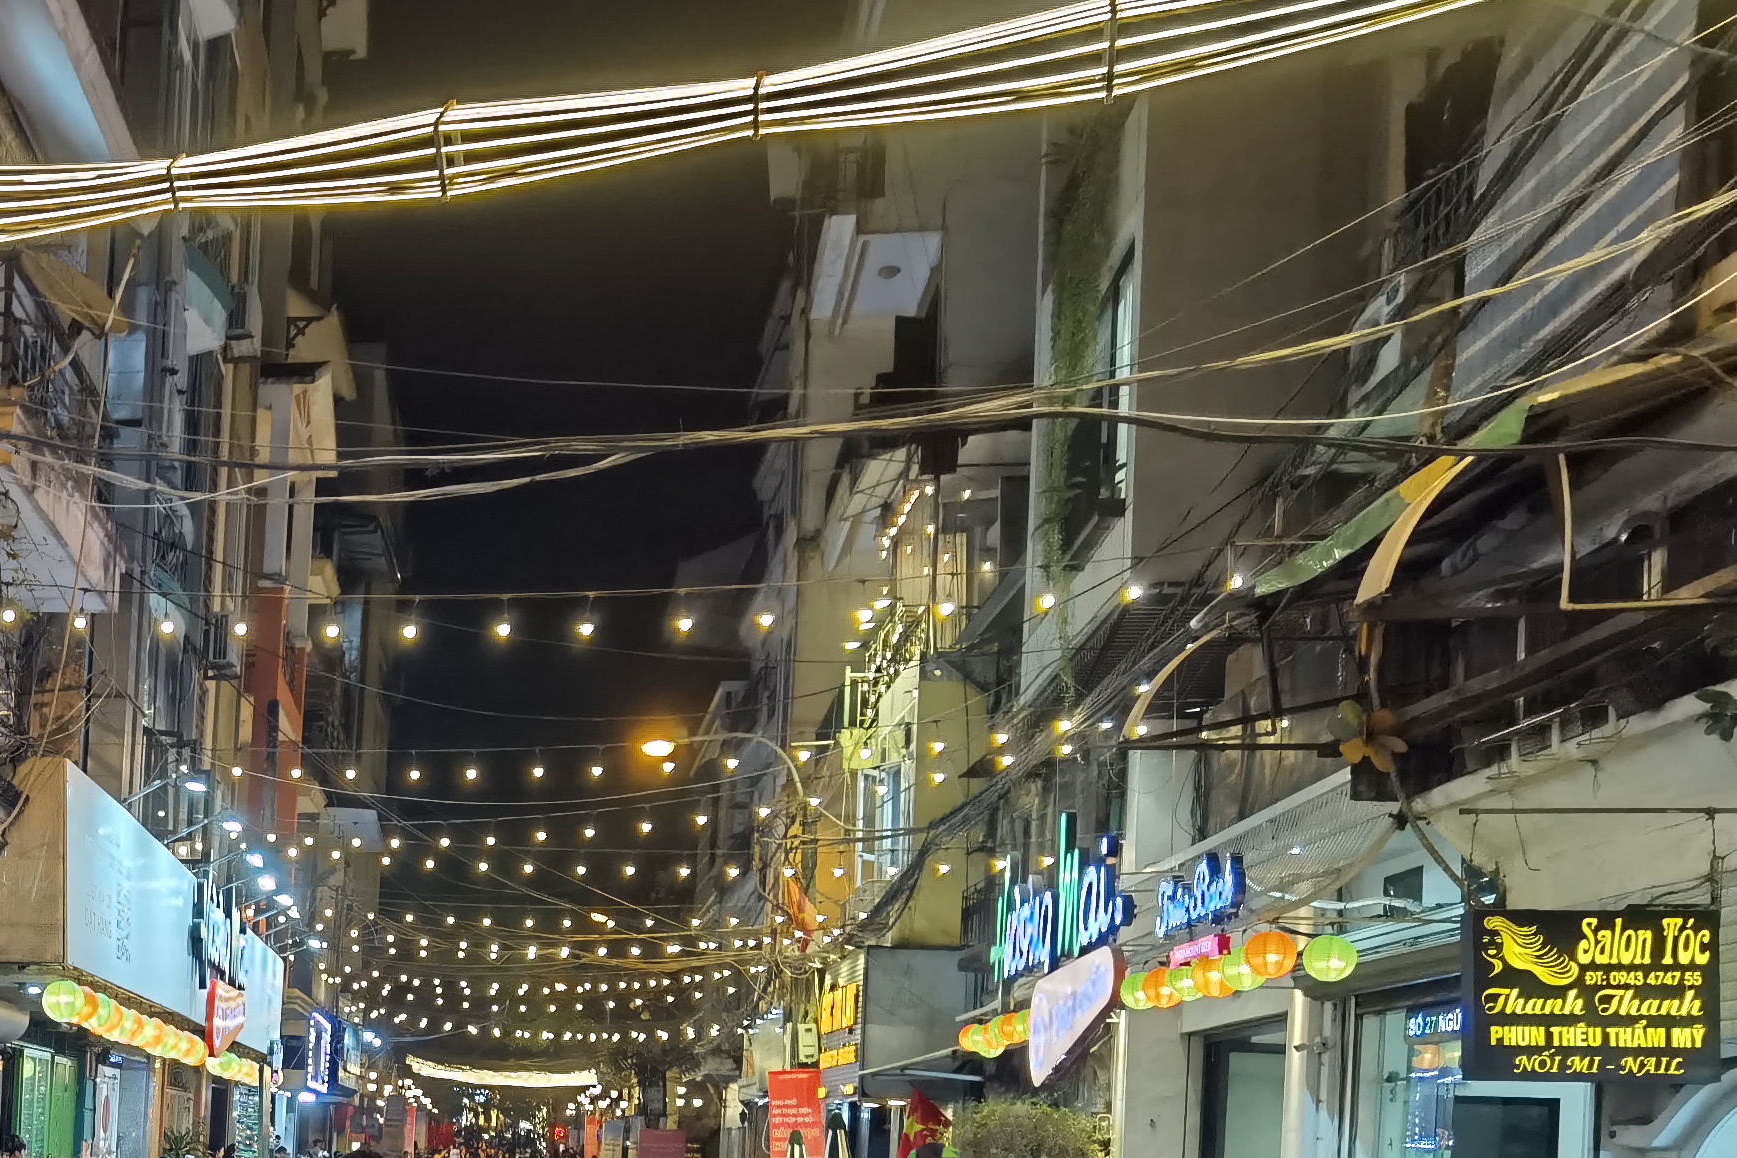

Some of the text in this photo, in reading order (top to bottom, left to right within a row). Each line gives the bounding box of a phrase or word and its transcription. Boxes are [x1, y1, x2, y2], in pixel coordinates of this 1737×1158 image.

[1577, 917, 1711, 966] Salon Tóc
[1585, 971, 1703, 986] ĐT: 0943 4747 55
[1481, 987, 1705, 1017] Thanh Thanh
[1490, 1019, 1707, 1049] PHUN THÊU THẨM MỸ
[1513, 1049, 1562, 1074] NỐI
[1565, 1056, 1602, 1074] MI
[1619, 1057, 1685, 1077] NAIL
